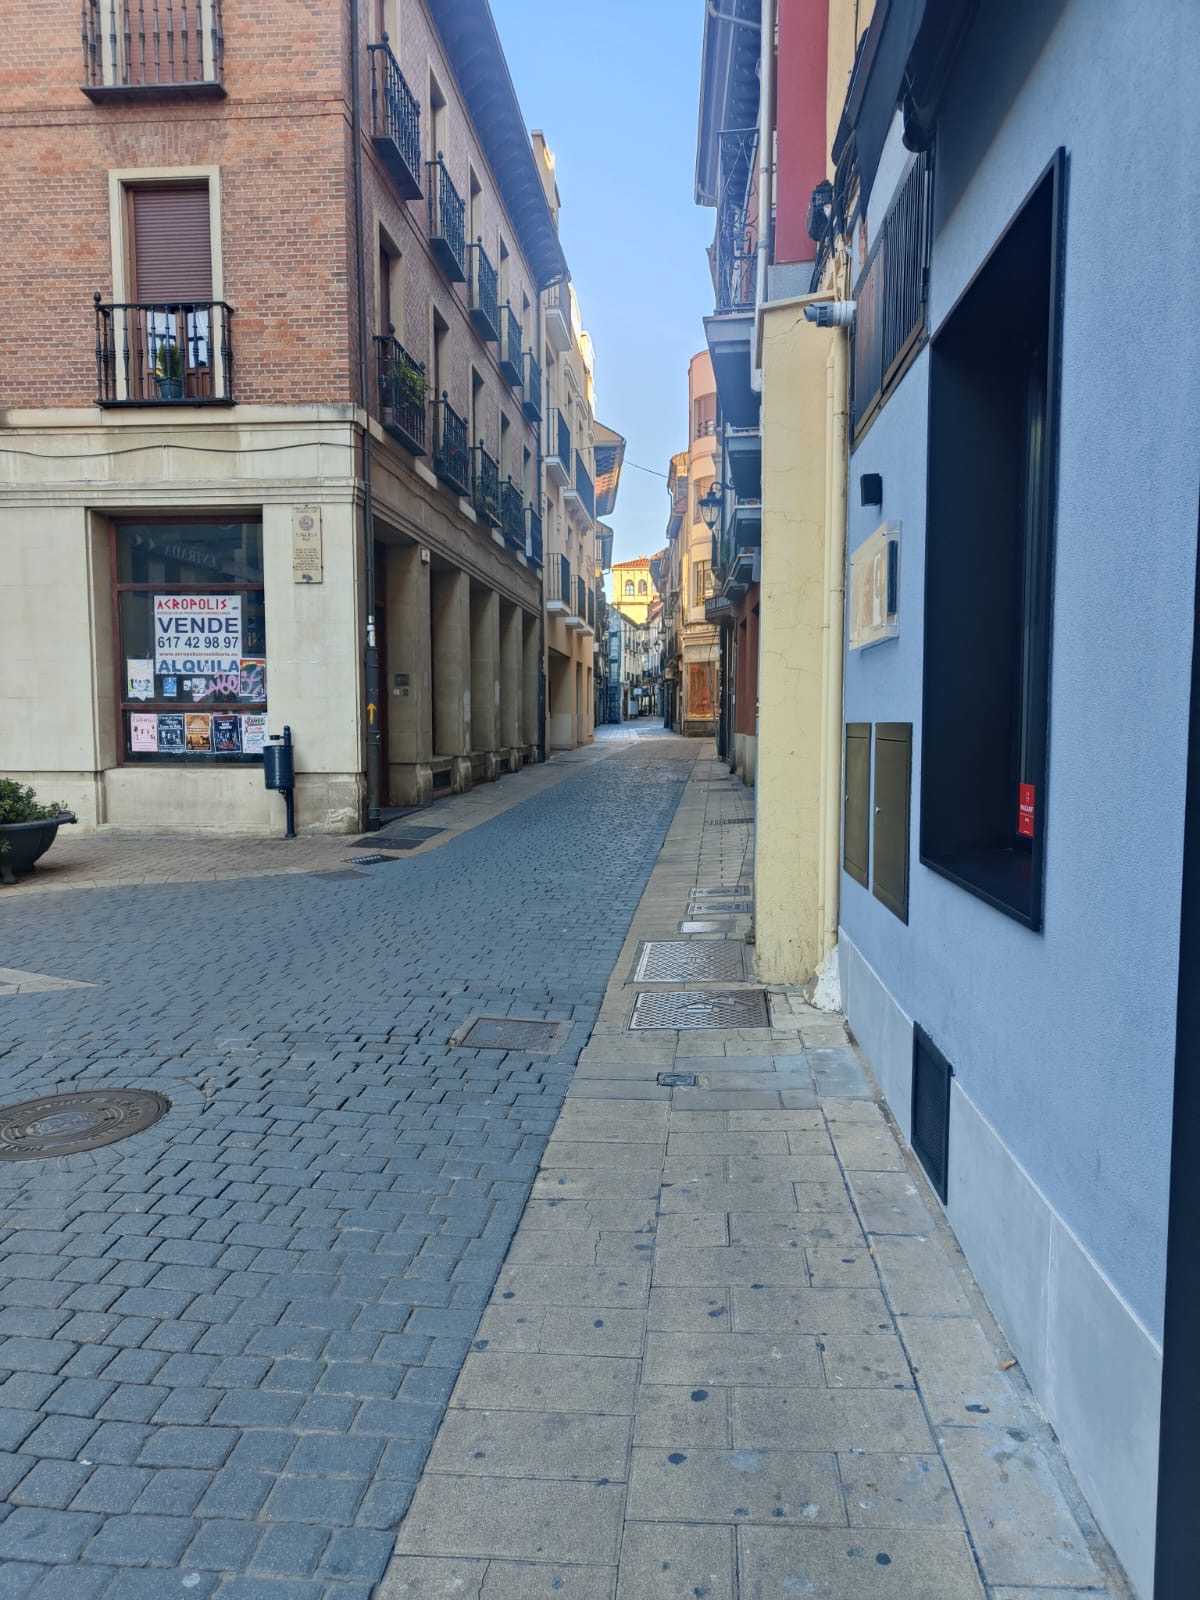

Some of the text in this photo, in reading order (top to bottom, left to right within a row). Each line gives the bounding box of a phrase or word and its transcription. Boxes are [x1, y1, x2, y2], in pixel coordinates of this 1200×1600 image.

[157, 598, 227, 610] ACROPOLIS
[157, 617, 239, 634] VENDE
[158, 636, 239, 649] 617 42 98 97
[158, 659, 240, 673] ALQUILA
